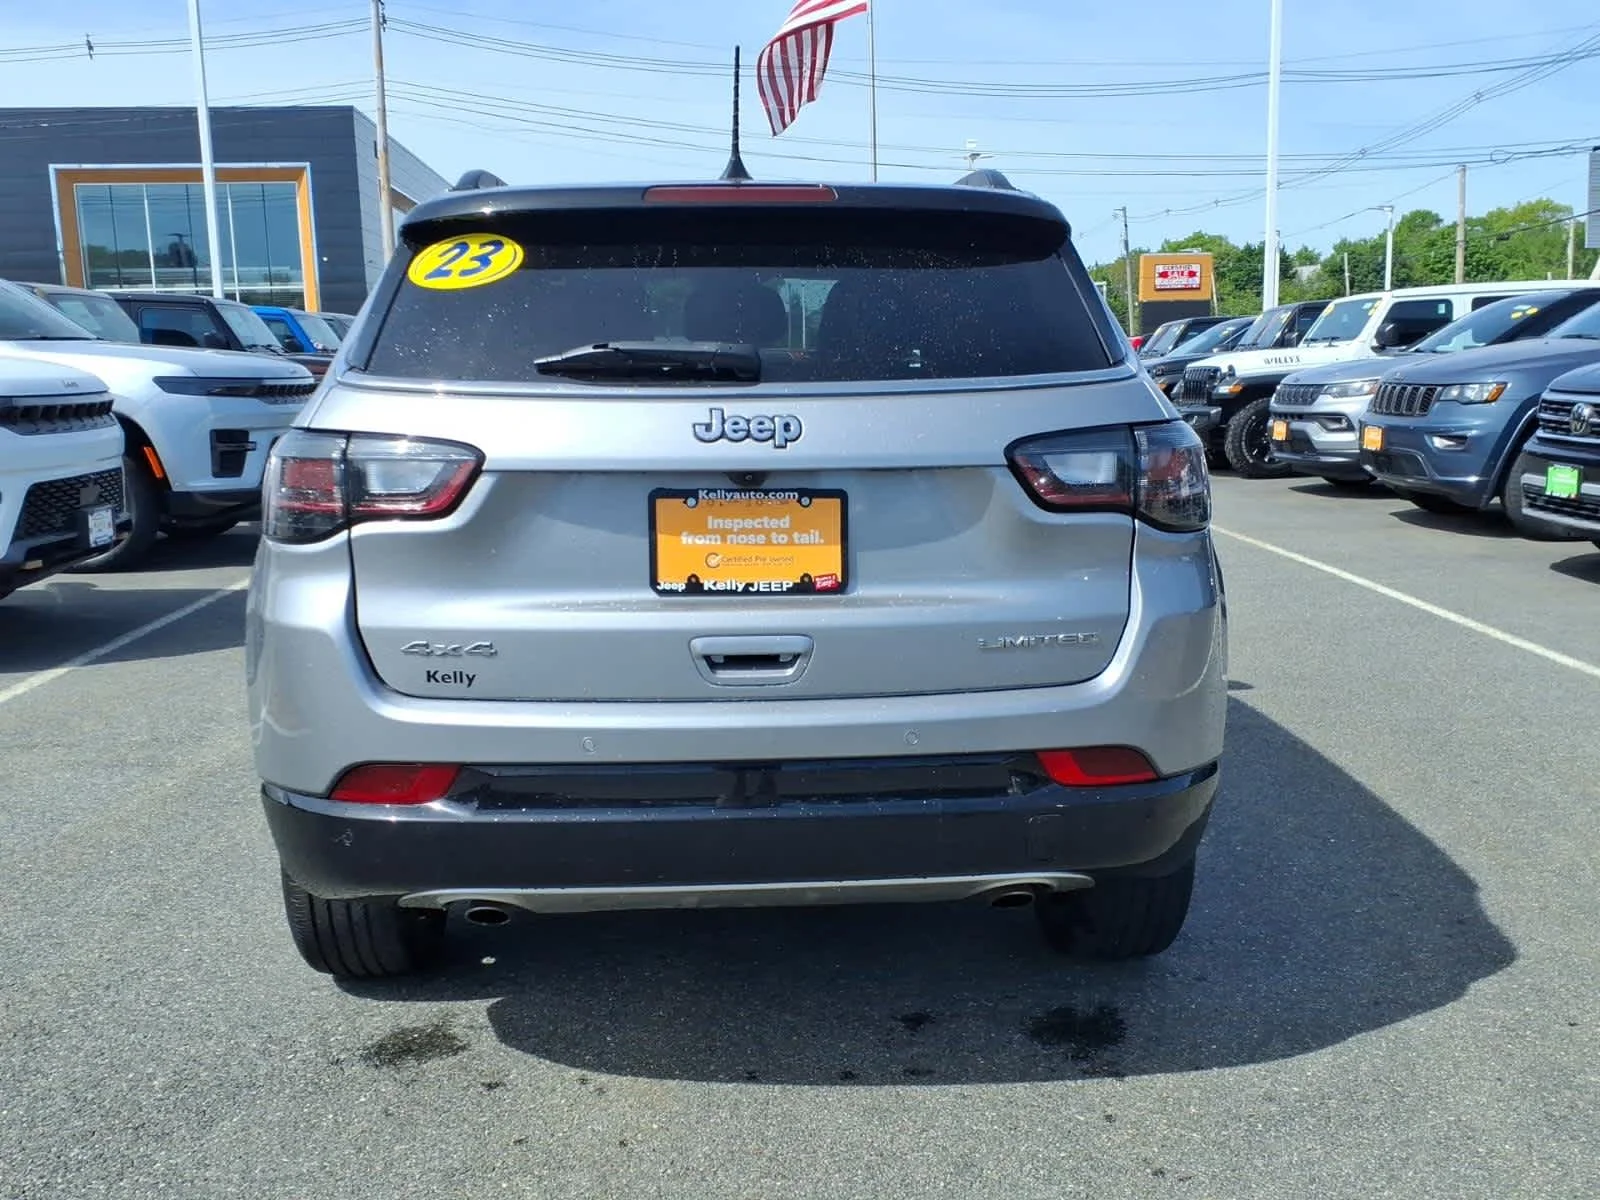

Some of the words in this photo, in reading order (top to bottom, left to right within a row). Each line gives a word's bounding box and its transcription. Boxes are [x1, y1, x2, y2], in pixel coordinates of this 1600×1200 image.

[424, 240, 504, 280] 23
[693, 408, 803, 449] Jeep
[699, 489, 799, 501] Kellyauto.com
[707, 515, 791, 531] Inspected
[681, 532, 721, 545] from
[727, 534, 765, 545] nose
[771, 532, 788, 545] to
[793, 530, 825, 545] tail.
[656, 582, 687, 592] Jeep
[703, 580, 746, 592] Kelly
[749, 581, 794, 592] JEEP
[400, 640, 498, 657] 4x4
[978, 632, 1099, 649] LIMITED
[426, 670, 476, 688] Kelly
